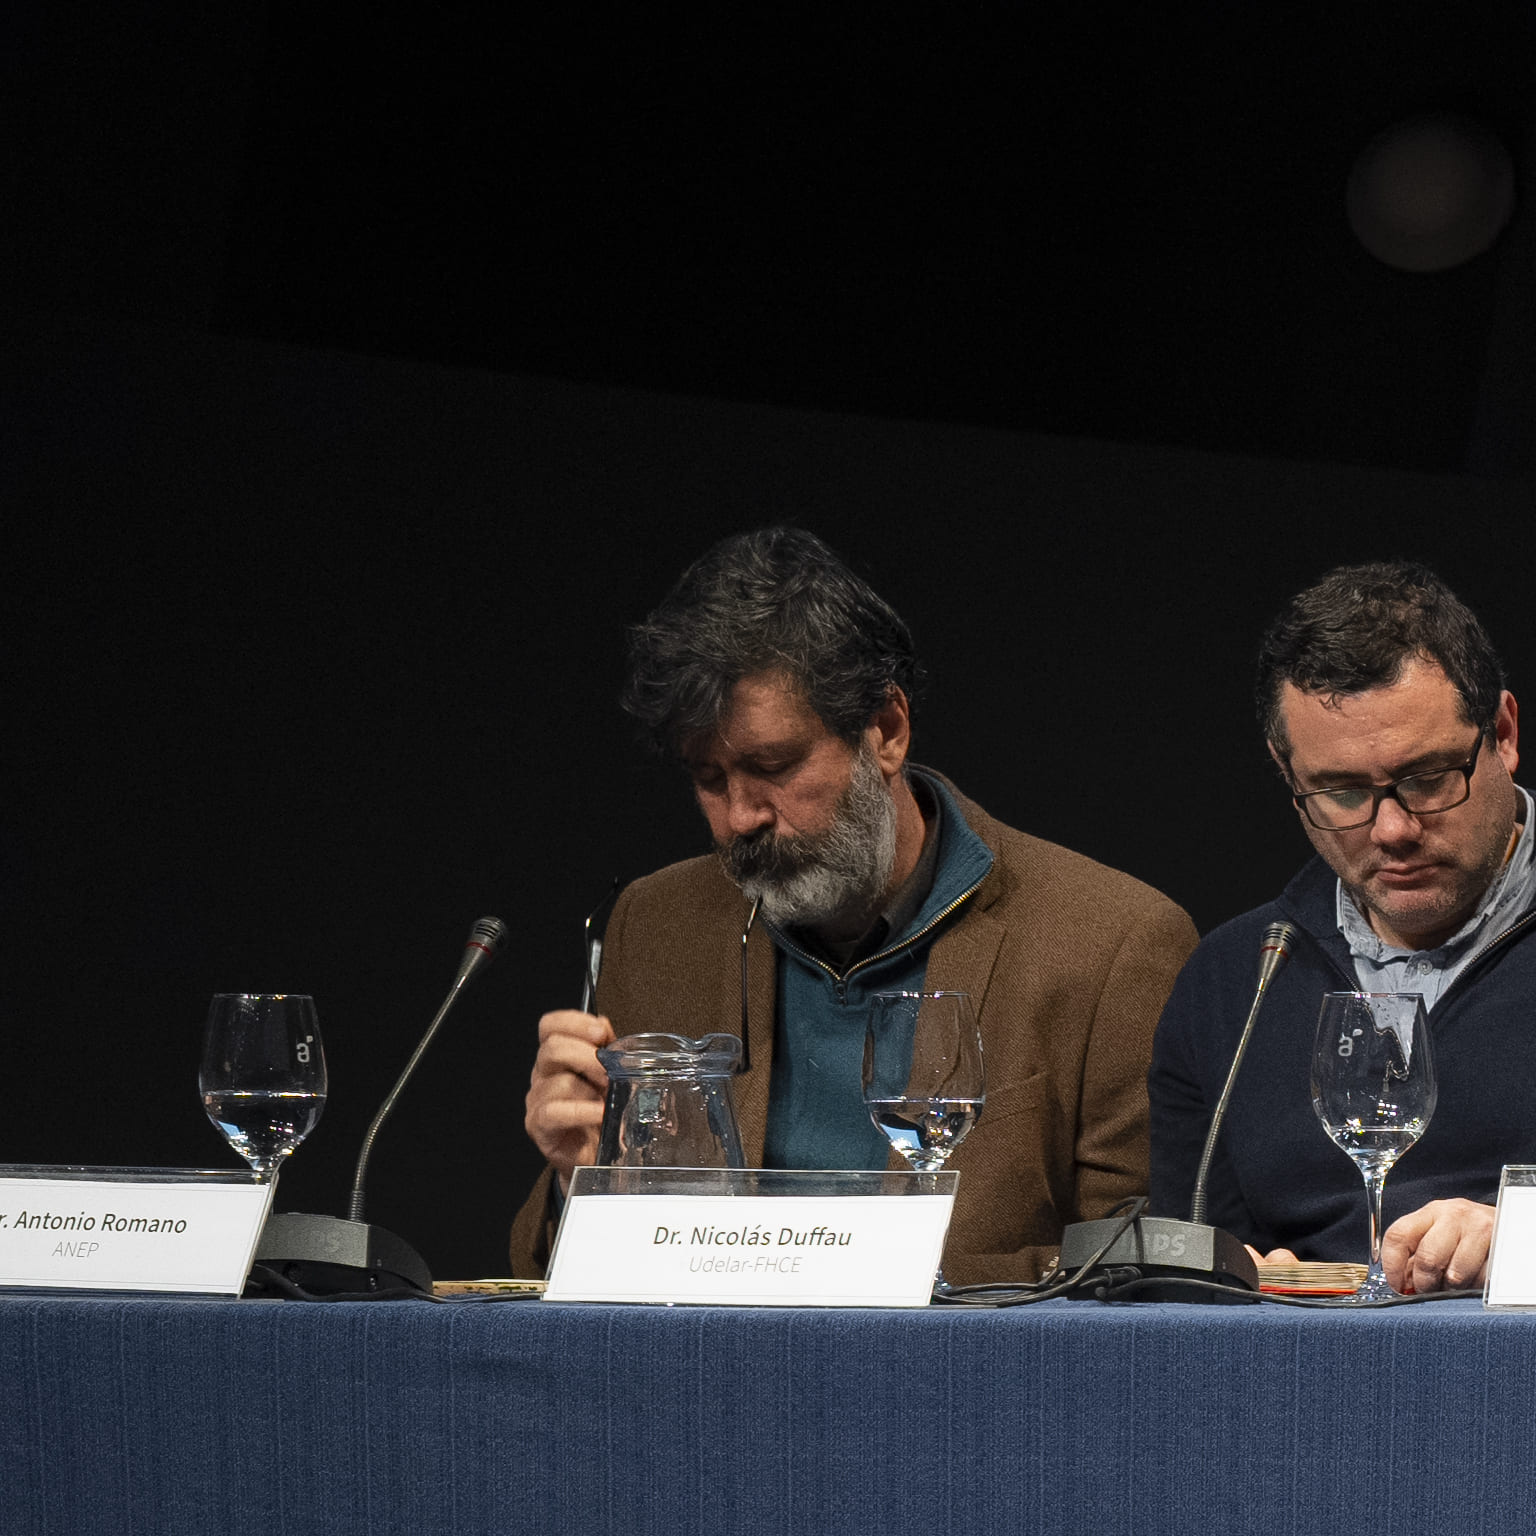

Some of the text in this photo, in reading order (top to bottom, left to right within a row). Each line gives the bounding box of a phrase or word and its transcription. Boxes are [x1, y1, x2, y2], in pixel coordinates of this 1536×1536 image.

[13, 1210, 95, 1231] Antonio
[100, 1213, 188, 1234] Romano
[652, 1224, 852, 1247] Dr. Nicolás Duffau
[52, 1240, 99, 1258] ANEP
[689, 1256, 803, 1274] Udelar-FHCE
